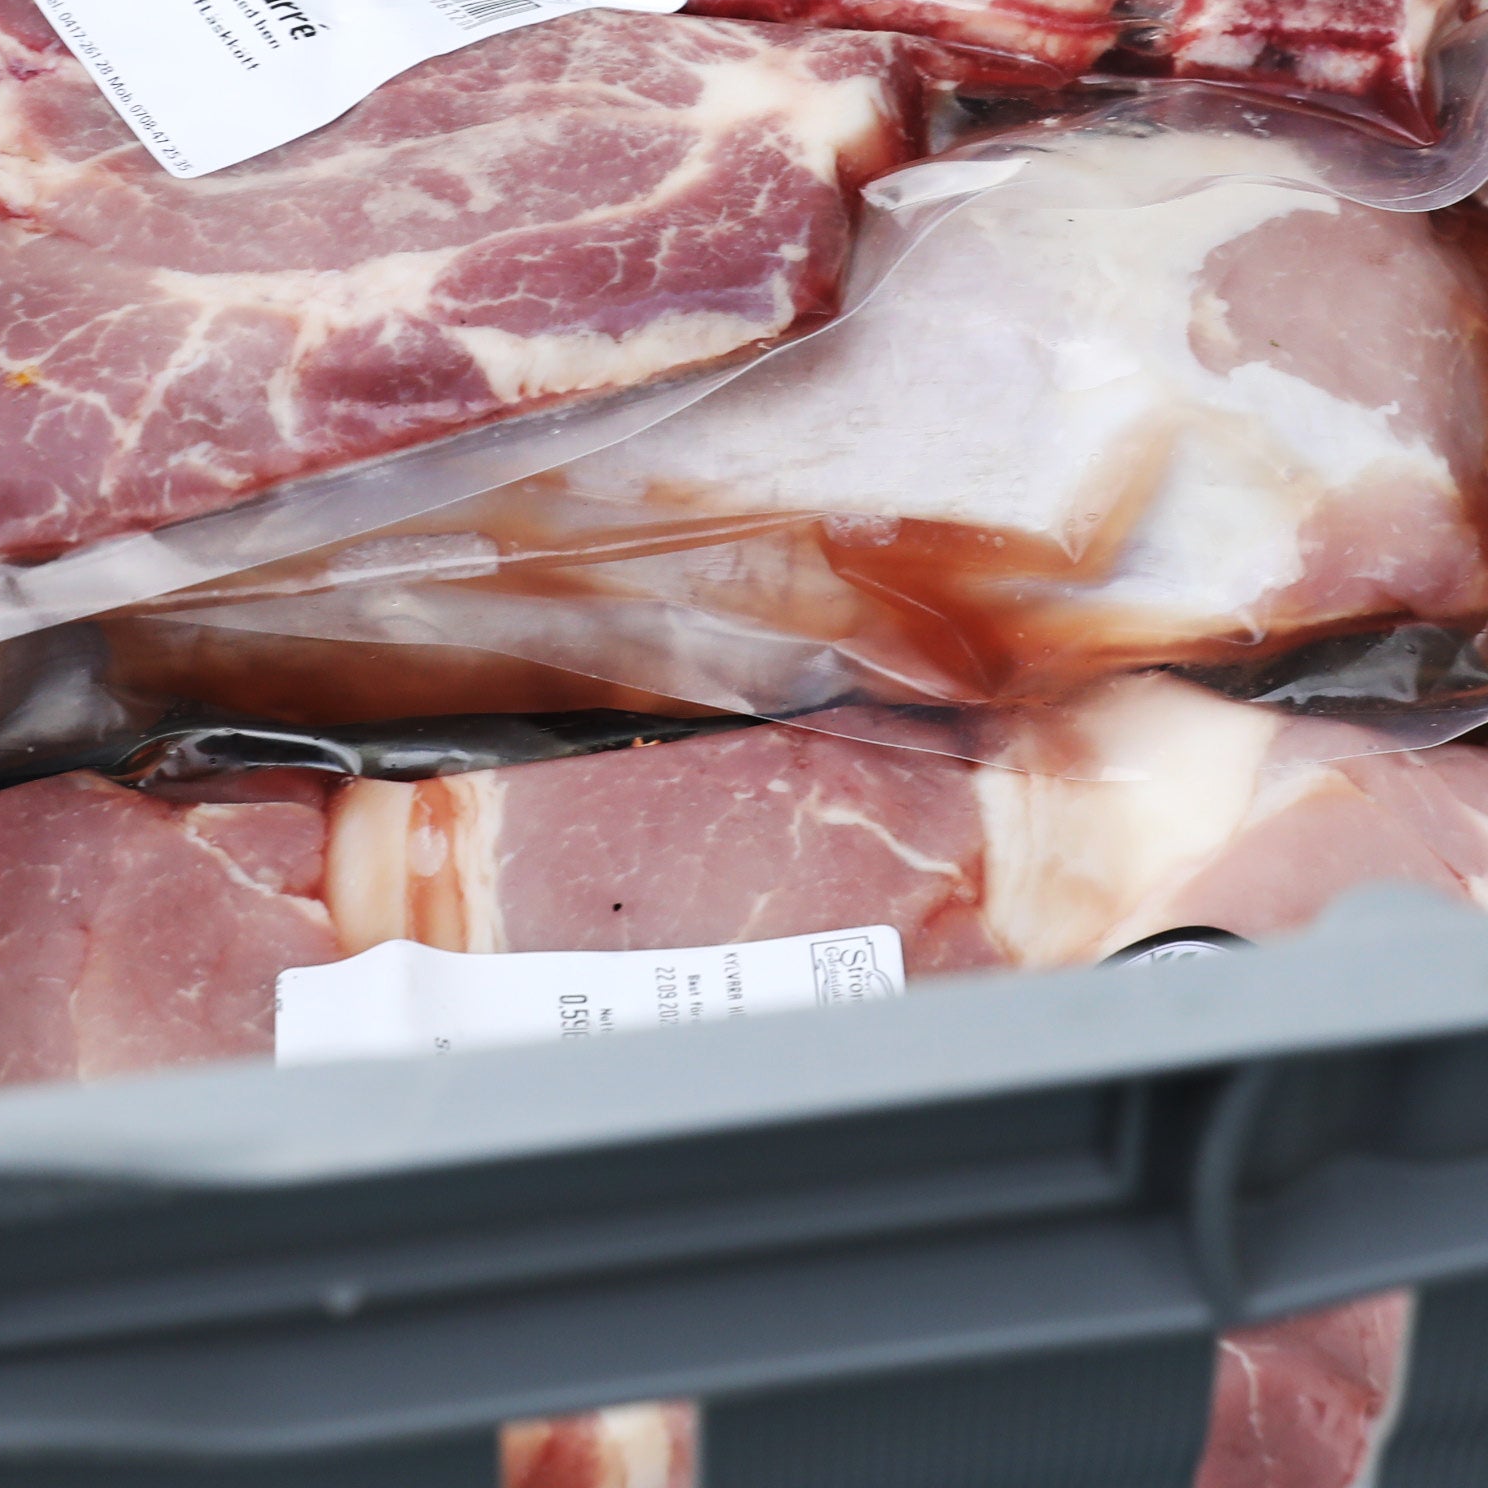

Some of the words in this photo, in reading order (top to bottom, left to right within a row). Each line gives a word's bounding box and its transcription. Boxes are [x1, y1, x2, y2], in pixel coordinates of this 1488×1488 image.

[58, 12, 102, 60] 0417-261
[94, 59, 114, 76] 28
[107, 75, 132, 106] Mob.
[129, 104, 171, 145] 0708-47
[162, 145, 183, 161] 25
[173, 159, 193, 172] 35
[723, 952, 743, 1001] KYLVARA
